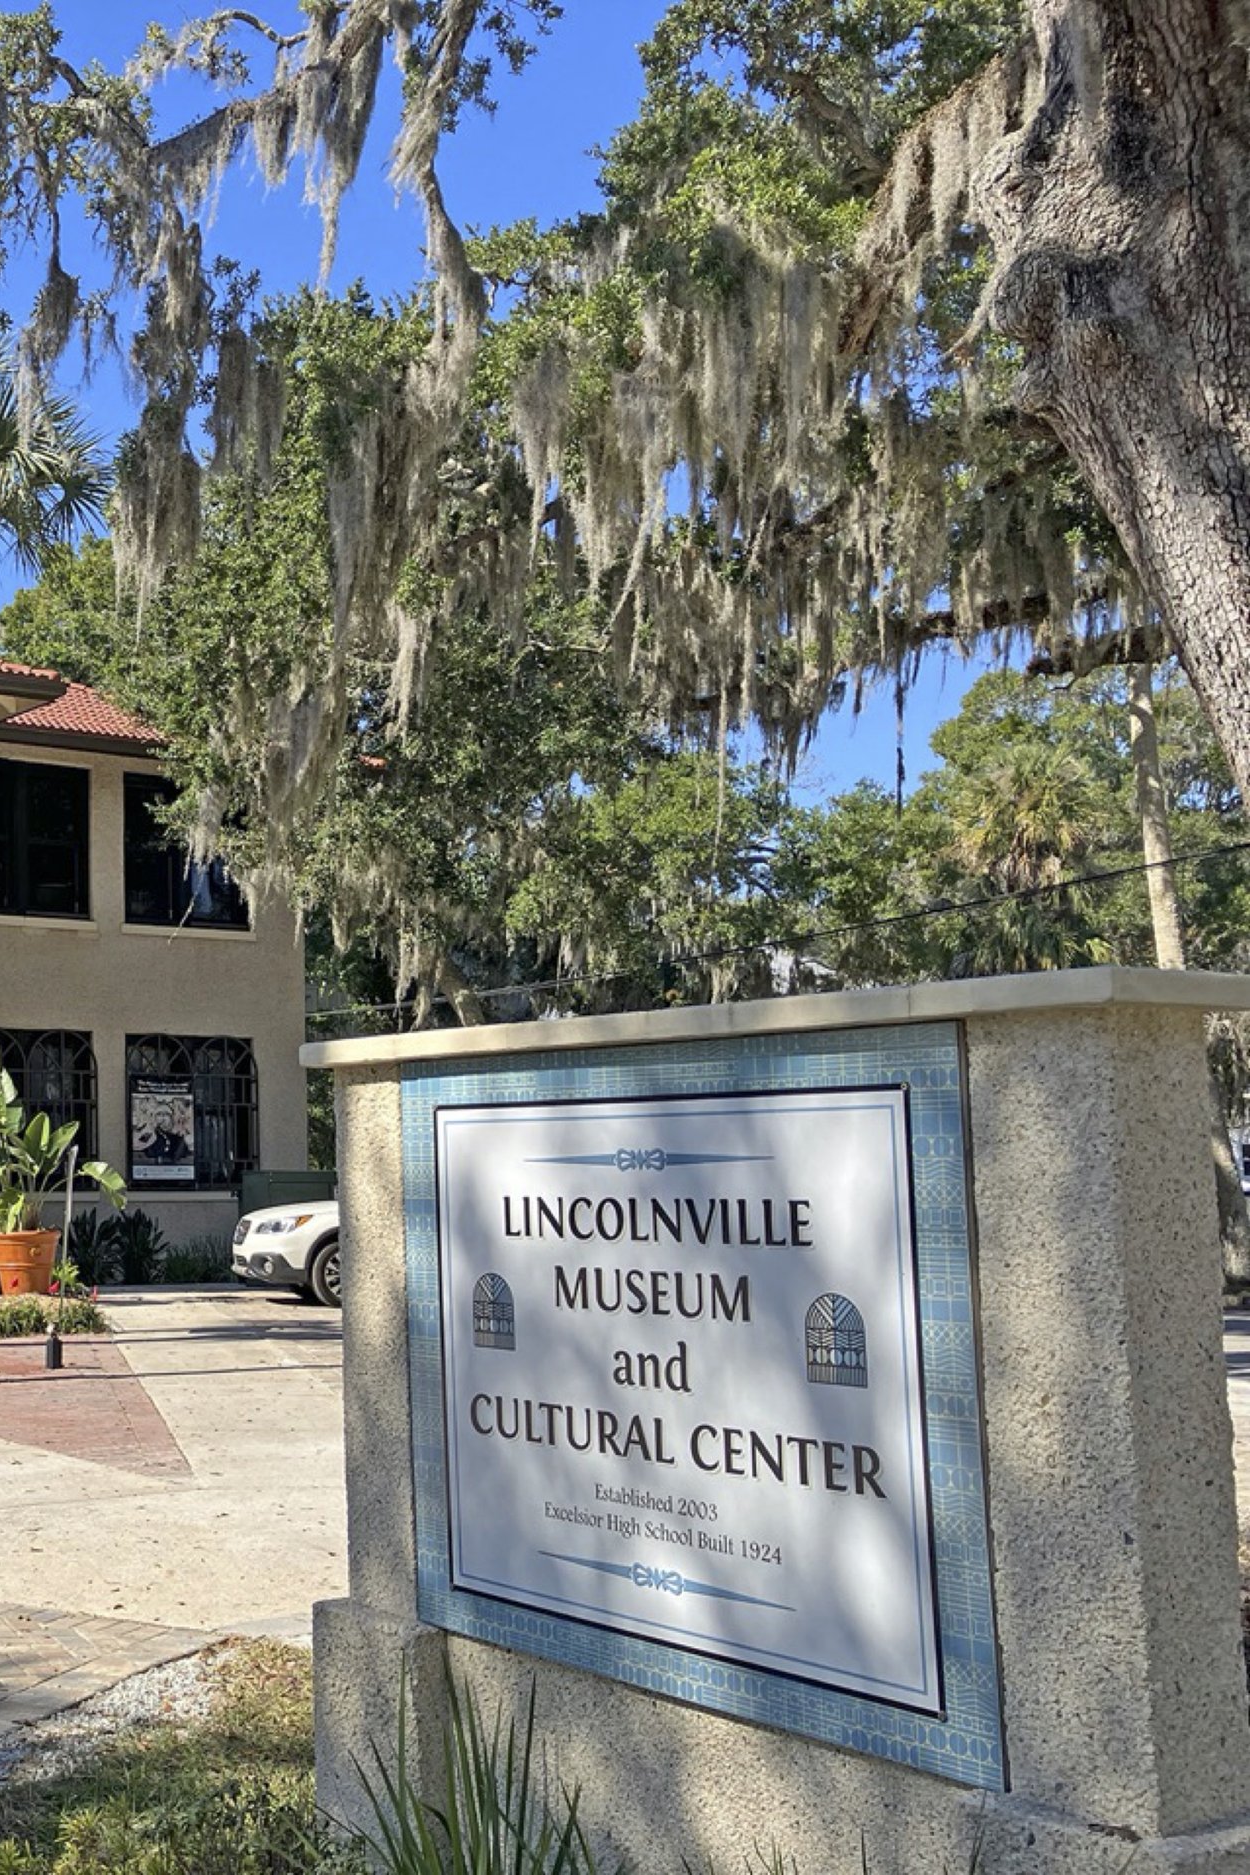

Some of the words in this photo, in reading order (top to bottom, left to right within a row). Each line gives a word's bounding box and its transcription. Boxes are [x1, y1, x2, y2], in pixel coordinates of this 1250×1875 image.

[503, 1196, 813, 1247] LINCOLNVILLE
[554, 1265, 751, 1322] MUSEUM
[613, 1341, 691, 1393] and
[470, 1394, 675, 1464] CULTURAL
[690, 1424, 887, 1499] CENTER
[595, 1483, 673, 1513] Established
[677, 1498, 718, 1521] 2003
[545, 1502, 603, 1528] Excelsior
[607, 1513, 640, 1539] High
[645, 1521, 693, 1547] School
[699, 1531, 734, 1555] Built
[741, 1540, 782, 1564] 1924
